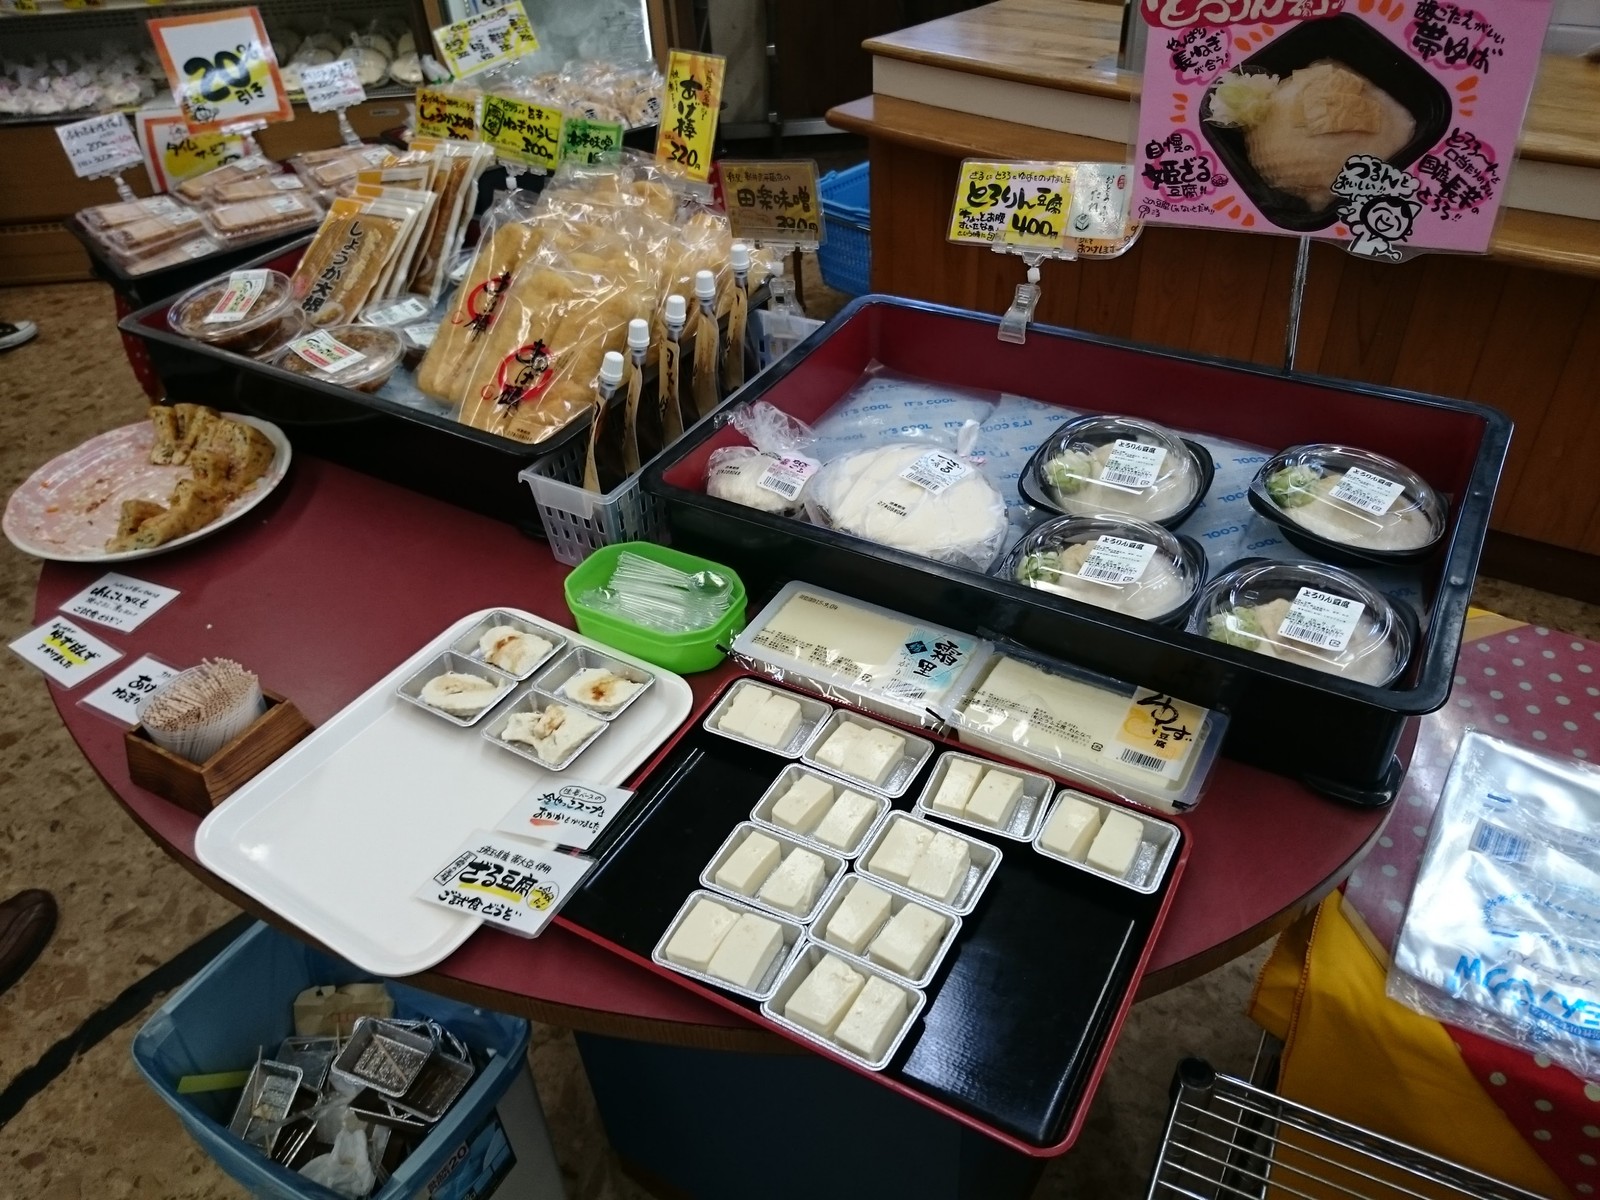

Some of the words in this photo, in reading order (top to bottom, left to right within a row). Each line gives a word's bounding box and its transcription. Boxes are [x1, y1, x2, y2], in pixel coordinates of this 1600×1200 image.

[1412, 21, 1503, 74] 帯ゆば
[672, 75, 703, 140] あげ棒
[1145, 133, 1194, 160] 自慢の
[1141, 156, 1211, 190] 姫ざる
[1345, 162, 1411, 190] つるんと
[737, 185, 811, 213] 田楽味噌
[967, 181, 1063, 214] とろりん豆腐
[1012, 211, 1059, 240] 400円
[862, 403, 892, 412] COOL
[926, 397, 957, 405] COOL
[901, 423, 932, 432] COOL
[1202, 526, 1239, 539] COOL
[1136, 693, 1193, 742] ゆず
[1154, 732, 1170, 749] 豆腐
[459, 860, 539, 897] ざる豆腐
